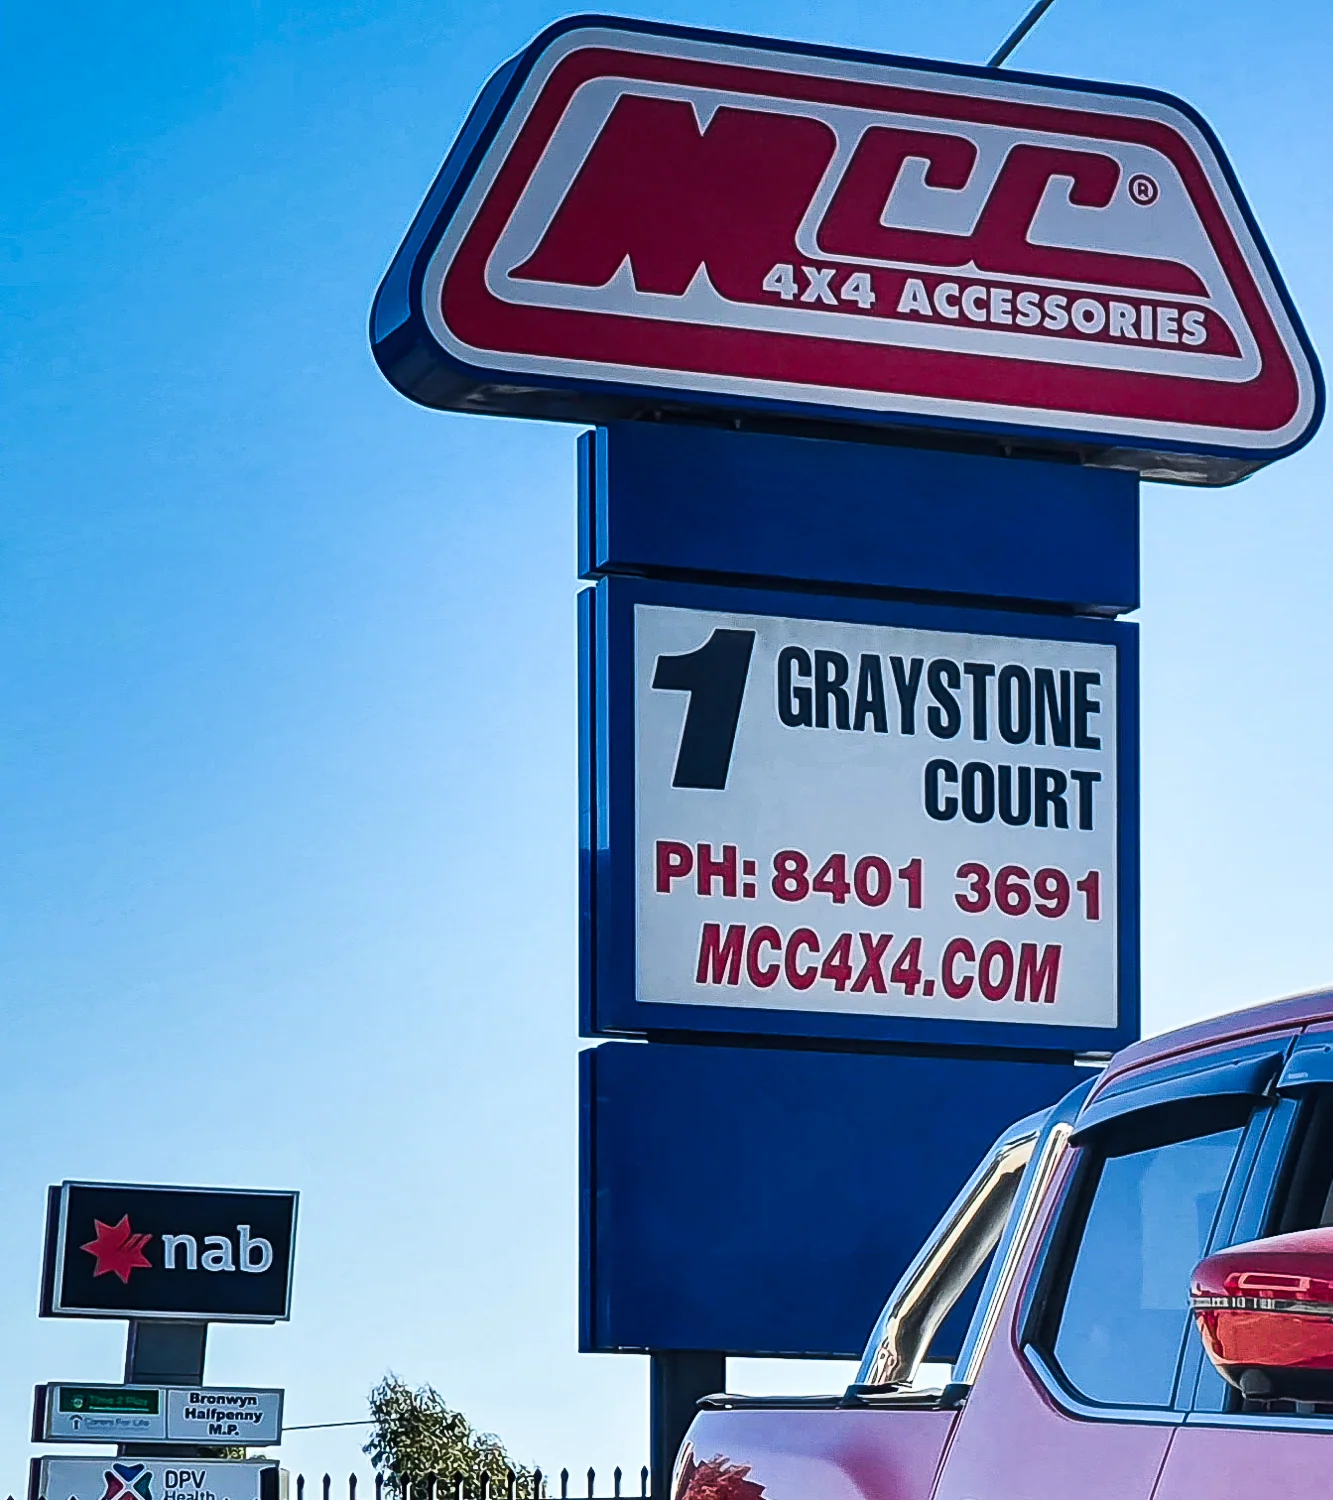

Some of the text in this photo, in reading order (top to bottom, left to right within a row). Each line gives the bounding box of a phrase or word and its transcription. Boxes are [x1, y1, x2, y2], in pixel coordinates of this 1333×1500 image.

[508, 94, 1211, 299] MCC
[762, 263, 1207, 346] 4X4 ACCESSORIES
[651, 628, 1102, 791] 1 GRAYSTONE
[924, 758, 1102, 831] COURT
[655, 841, 1101, 920] PH: 8401 3691
[696, 923, 1062, 1004] MCC4X4.COM
[162, 1225, 273, 1273] nab
[184, 1408, 263, 1423] Halfpenny
[189, 1392, 258, 1406] Bronwyn
[208, 1423, 240, 1436] M.P.
[165, 1470, 206, 1488] DPV
